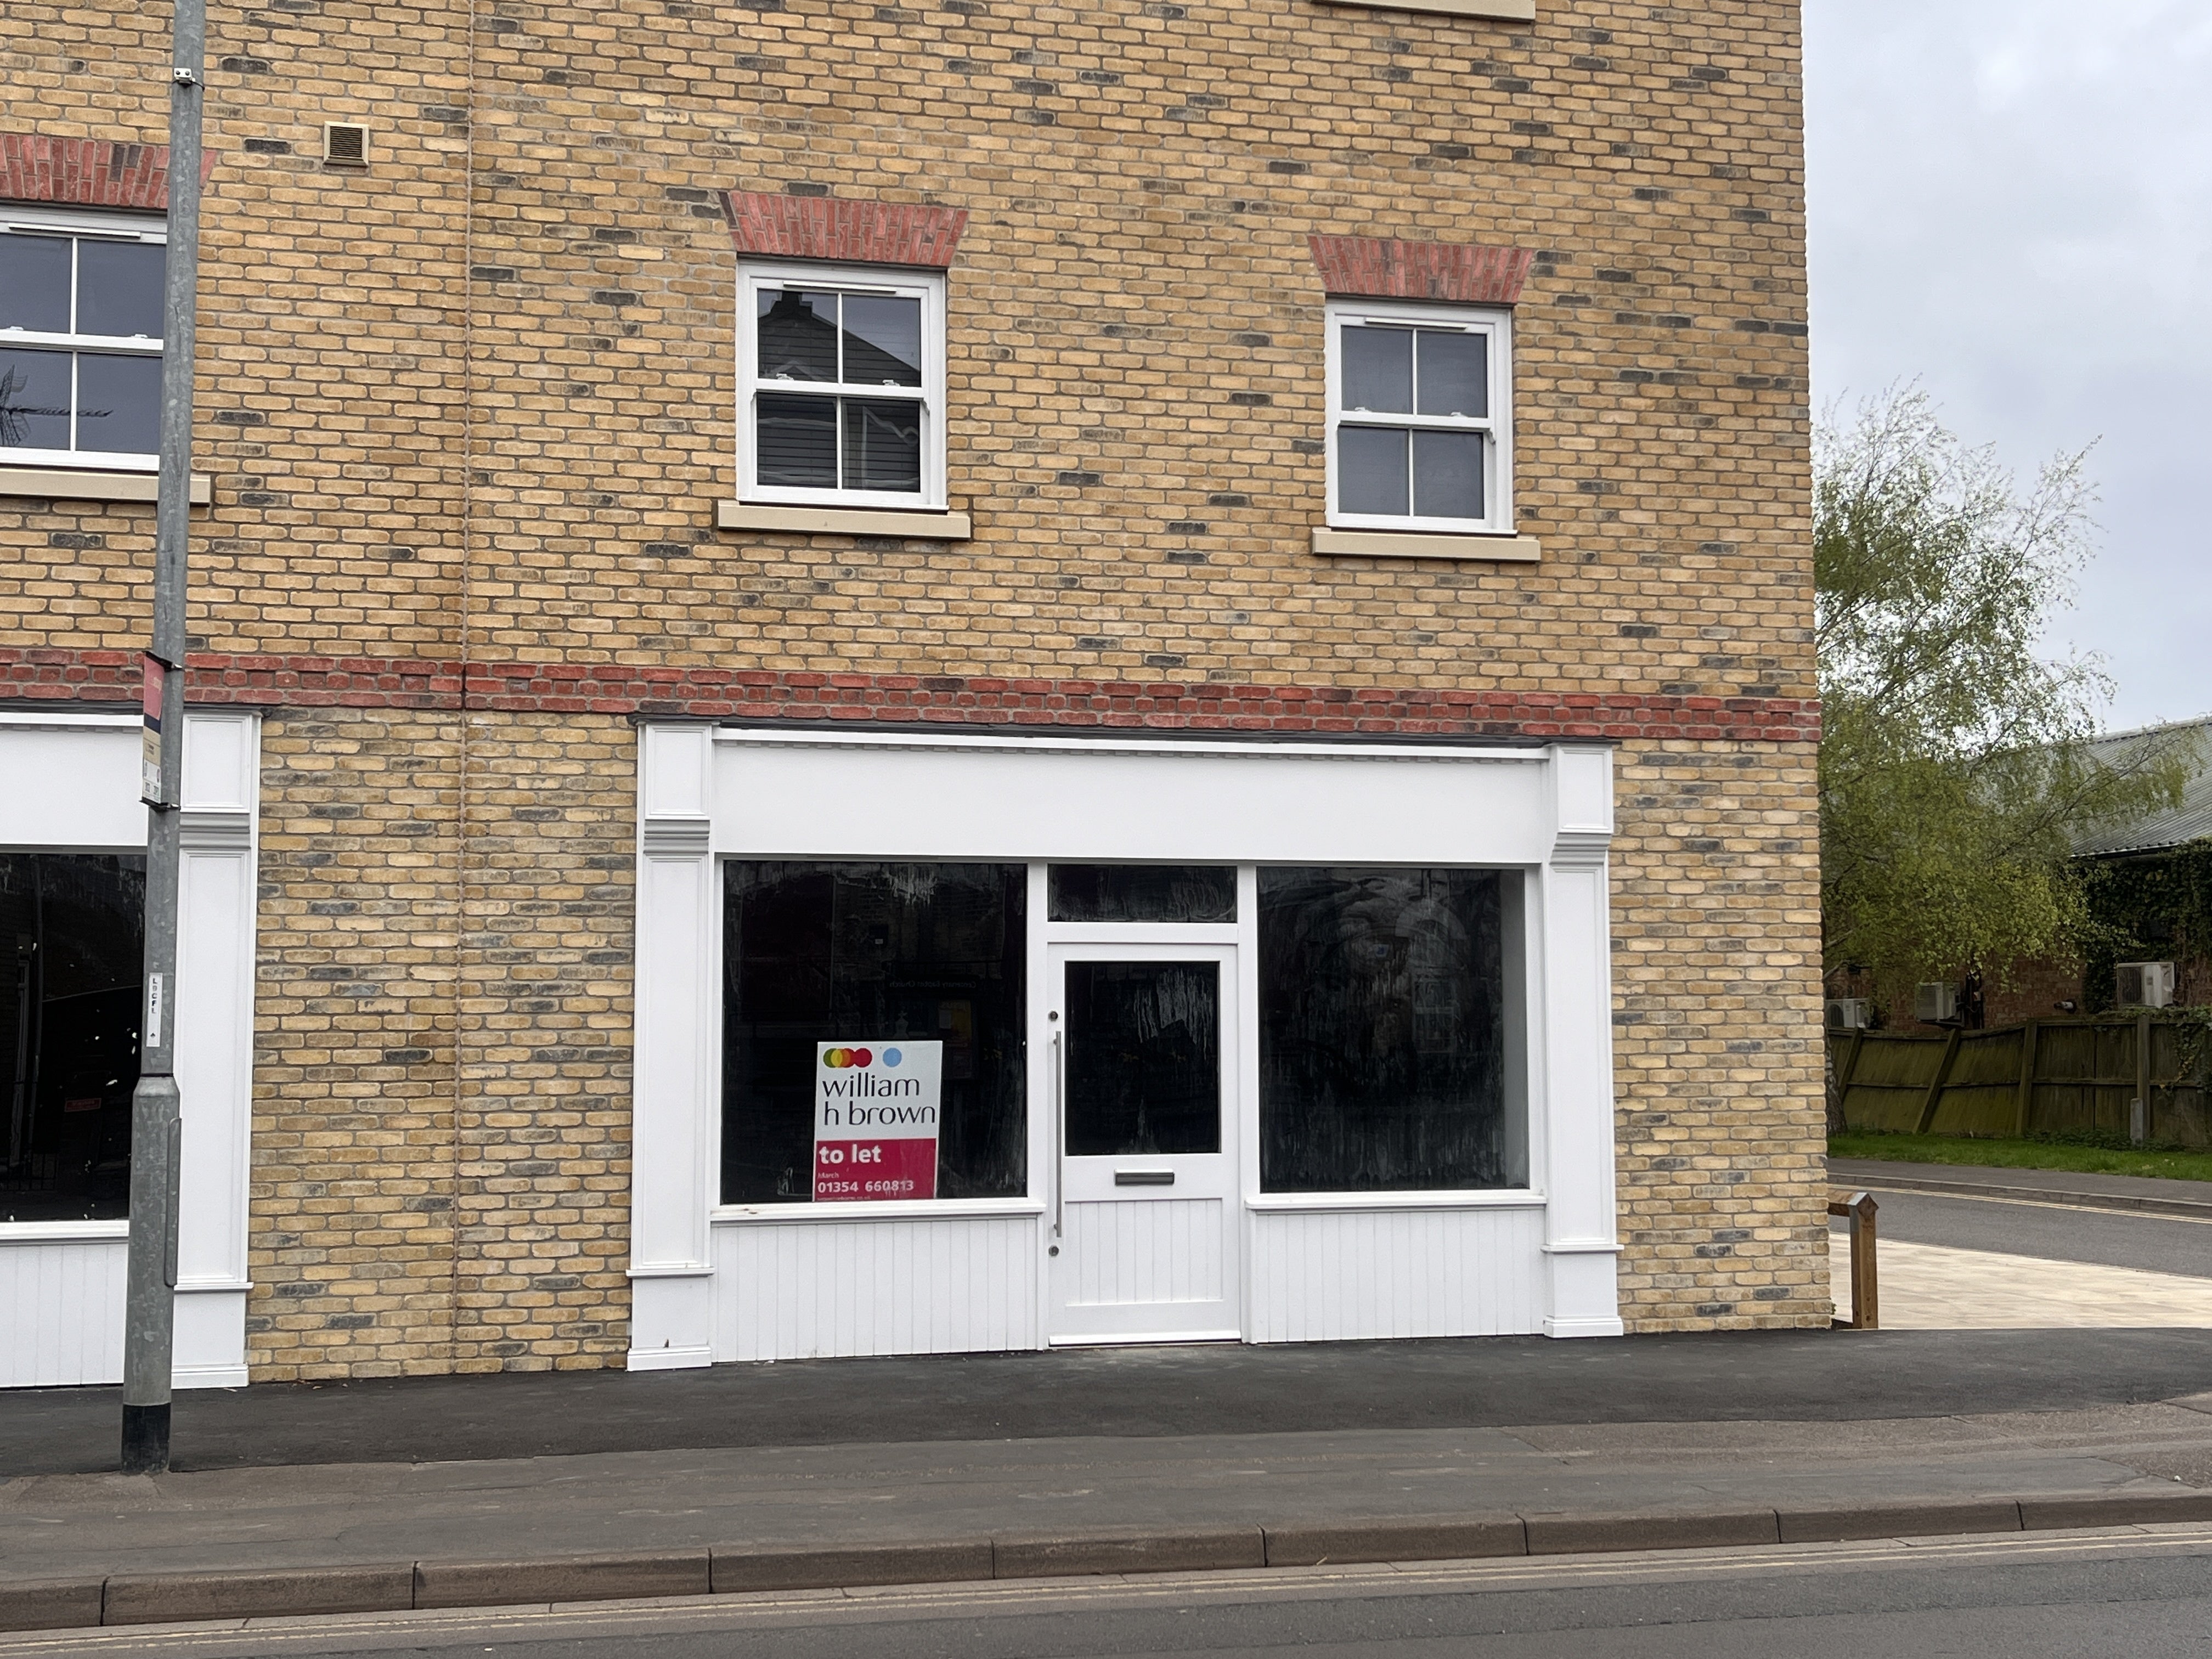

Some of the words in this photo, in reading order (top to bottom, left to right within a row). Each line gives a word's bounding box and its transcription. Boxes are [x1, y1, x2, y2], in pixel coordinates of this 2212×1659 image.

[822, 1073, 919, 1097] william
[825, 1101, 839, 1125] h
[849, 1101, 935, 1125] brown
[819, 1147, 844, 1164] to
[852, 1144, 882, 1163] let
[817, 1181, 859, 1193] 01354
[865, 1180, 914, 1192] 660813
